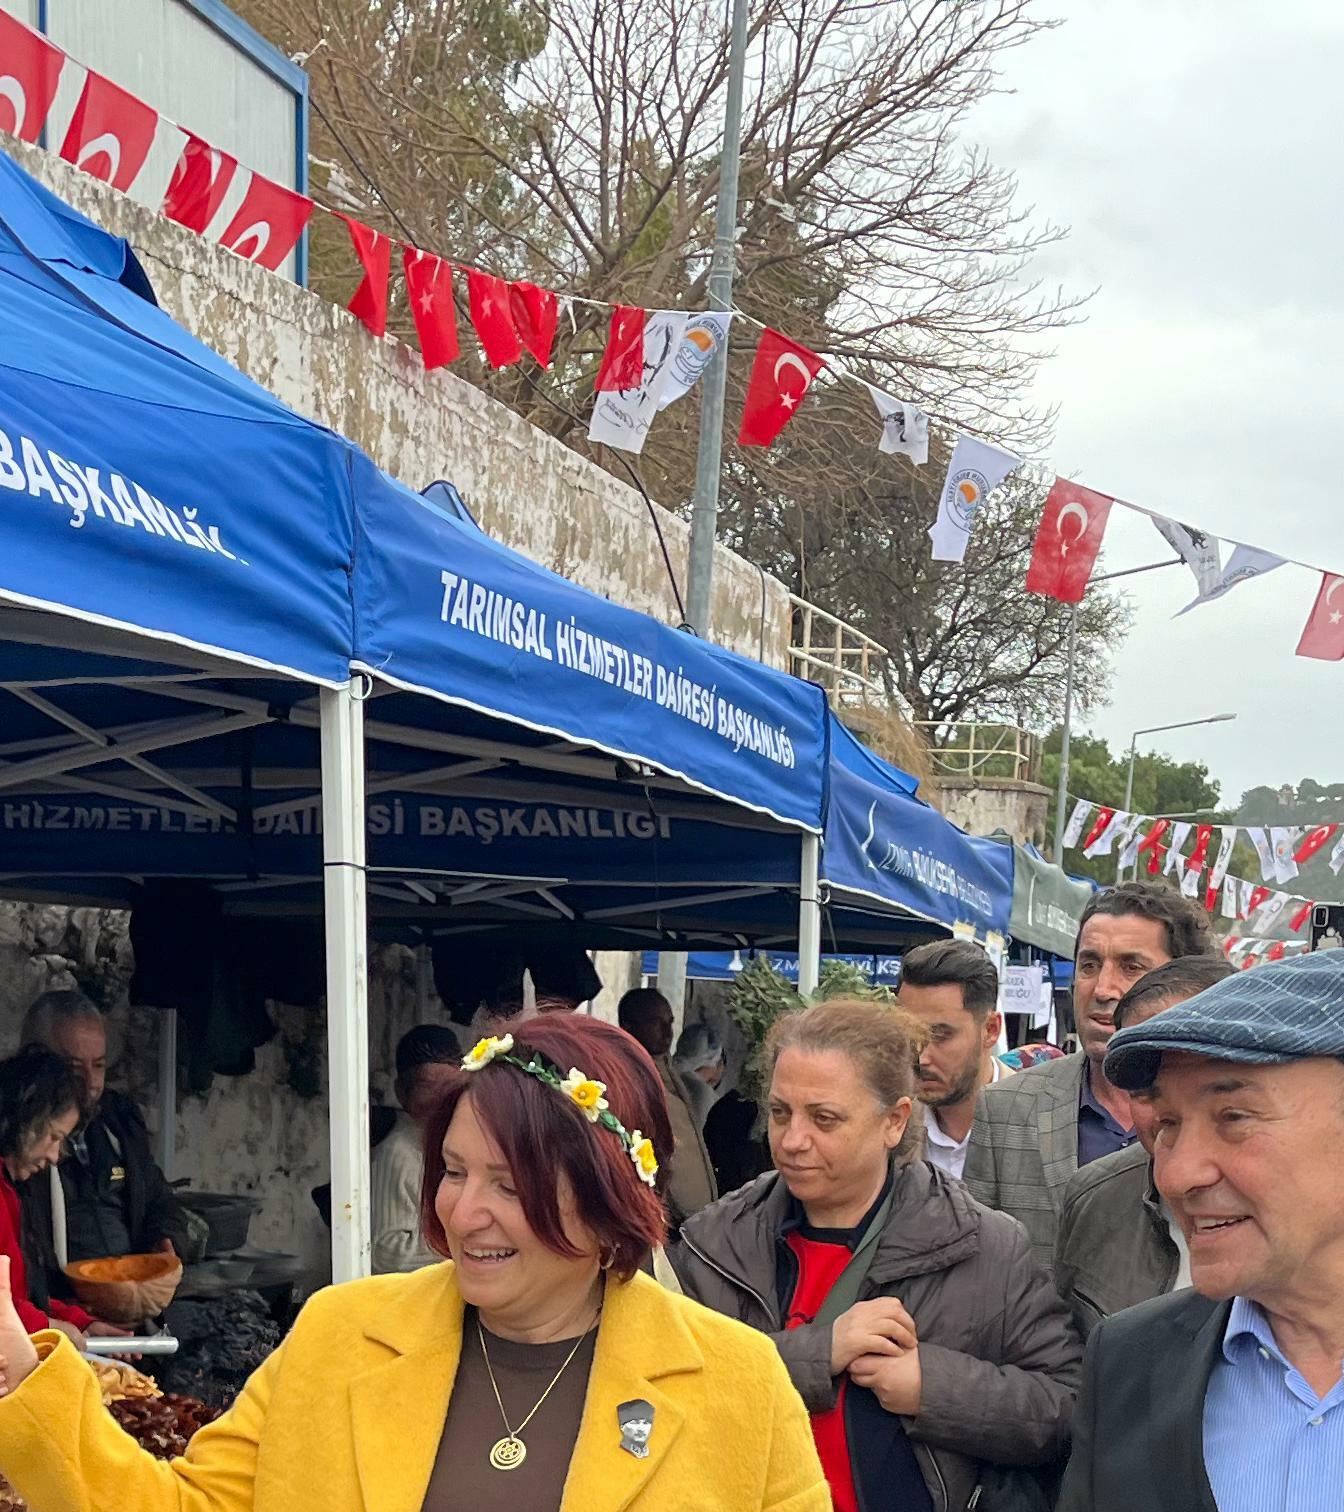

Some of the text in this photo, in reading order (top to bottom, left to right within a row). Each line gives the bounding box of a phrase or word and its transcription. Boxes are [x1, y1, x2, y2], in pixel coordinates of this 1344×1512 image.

[440, 570, 795, 769] TARIMSAL HİZMETLER DAİRESİ BAŞKANLIĞI
